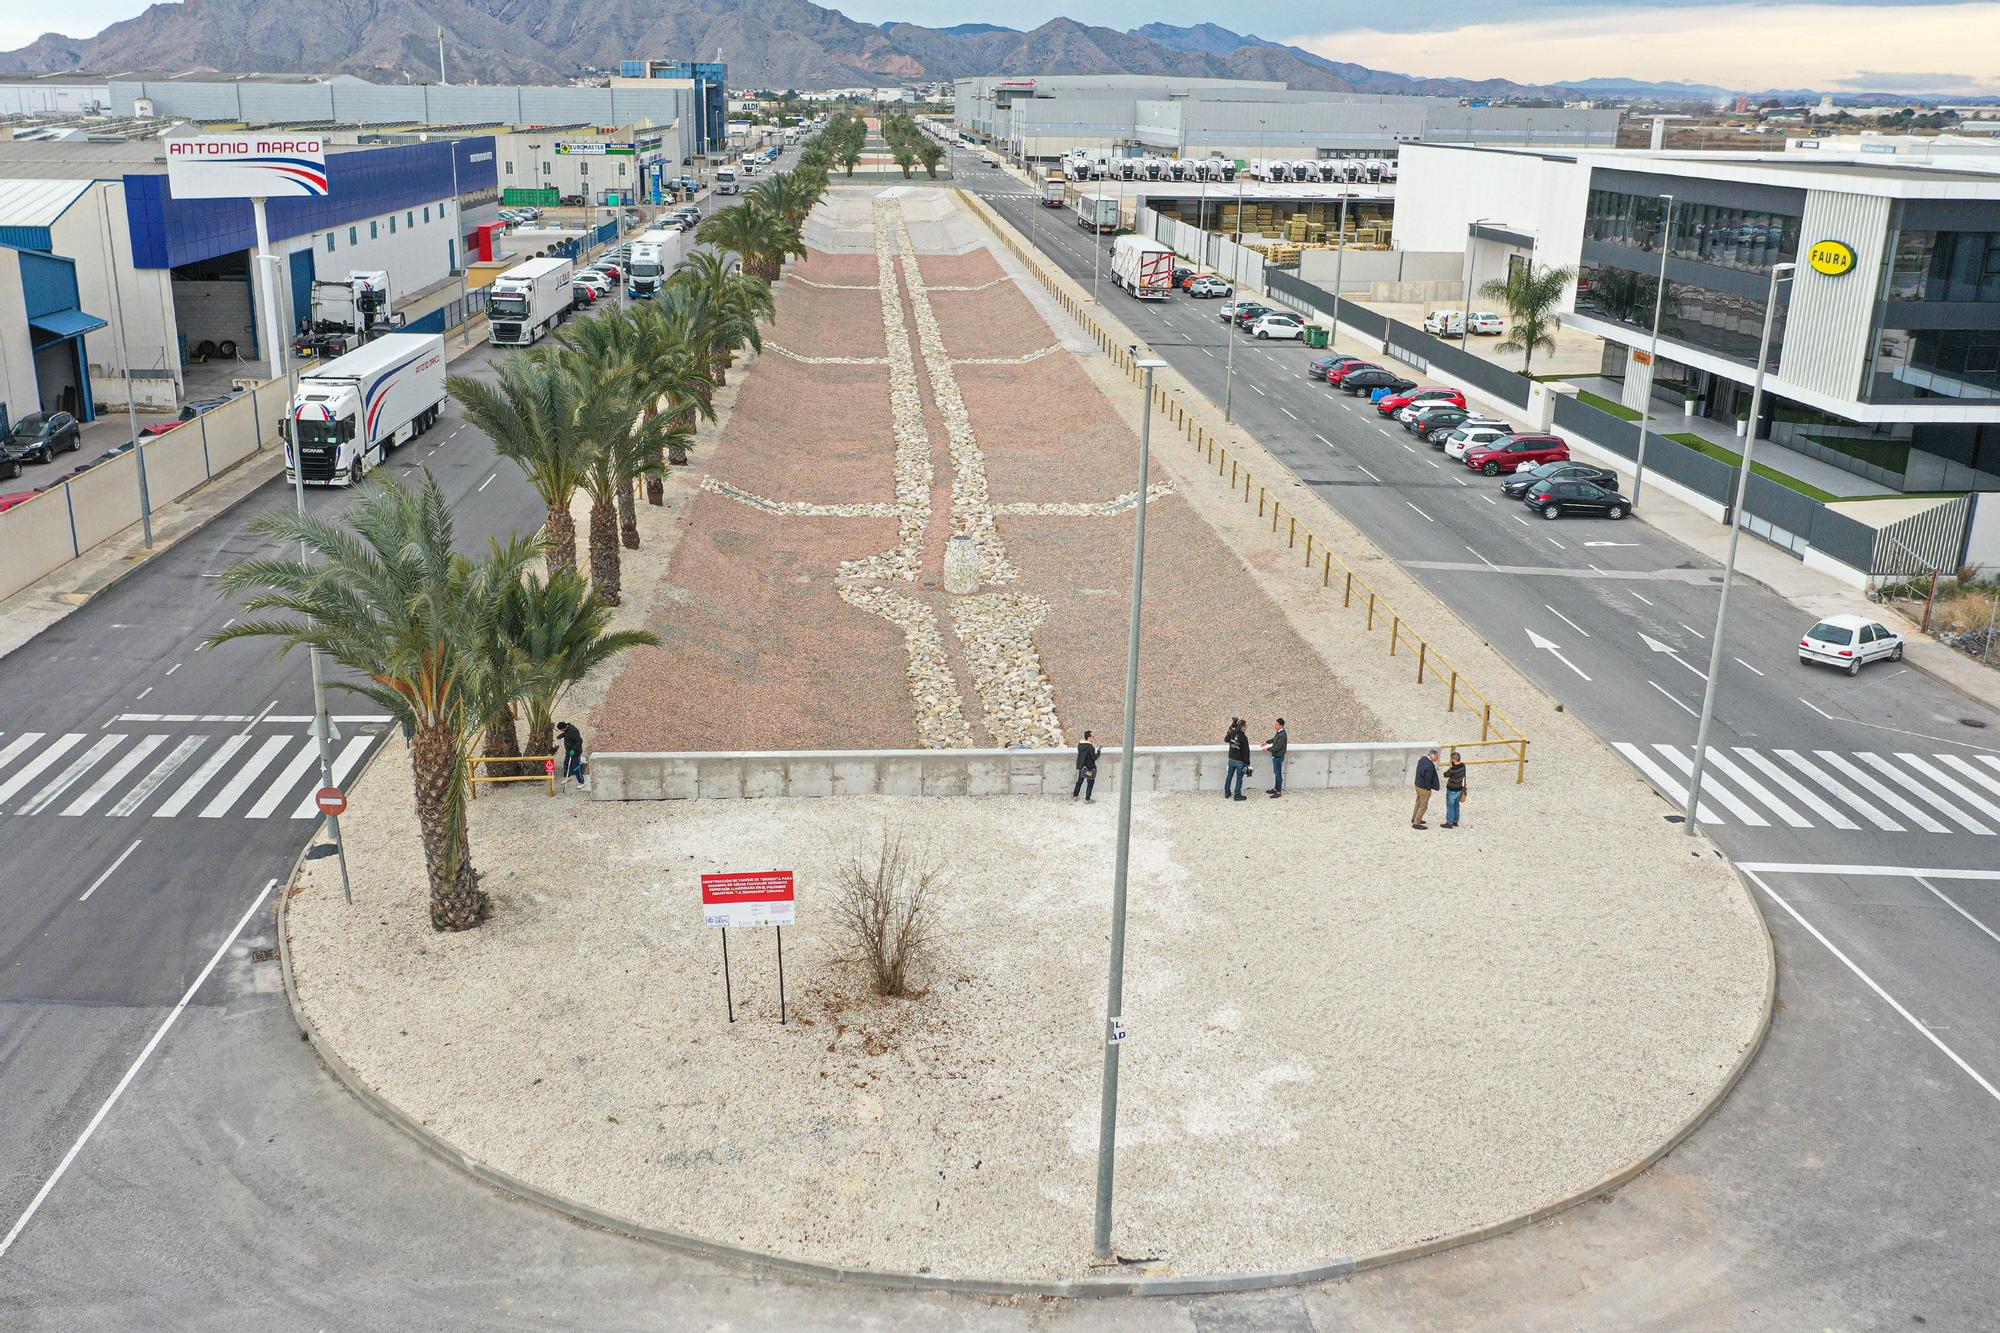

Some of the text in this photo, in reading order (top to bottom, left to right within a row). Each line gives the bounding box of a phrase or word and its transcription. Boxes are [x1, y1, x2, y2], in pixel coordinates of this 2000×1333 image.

[742, 103, 758, 111] ALDI
[170, 141, 319, 155] ANTONIO MARCO
[1811, 250, 1847, 267] FAURA
